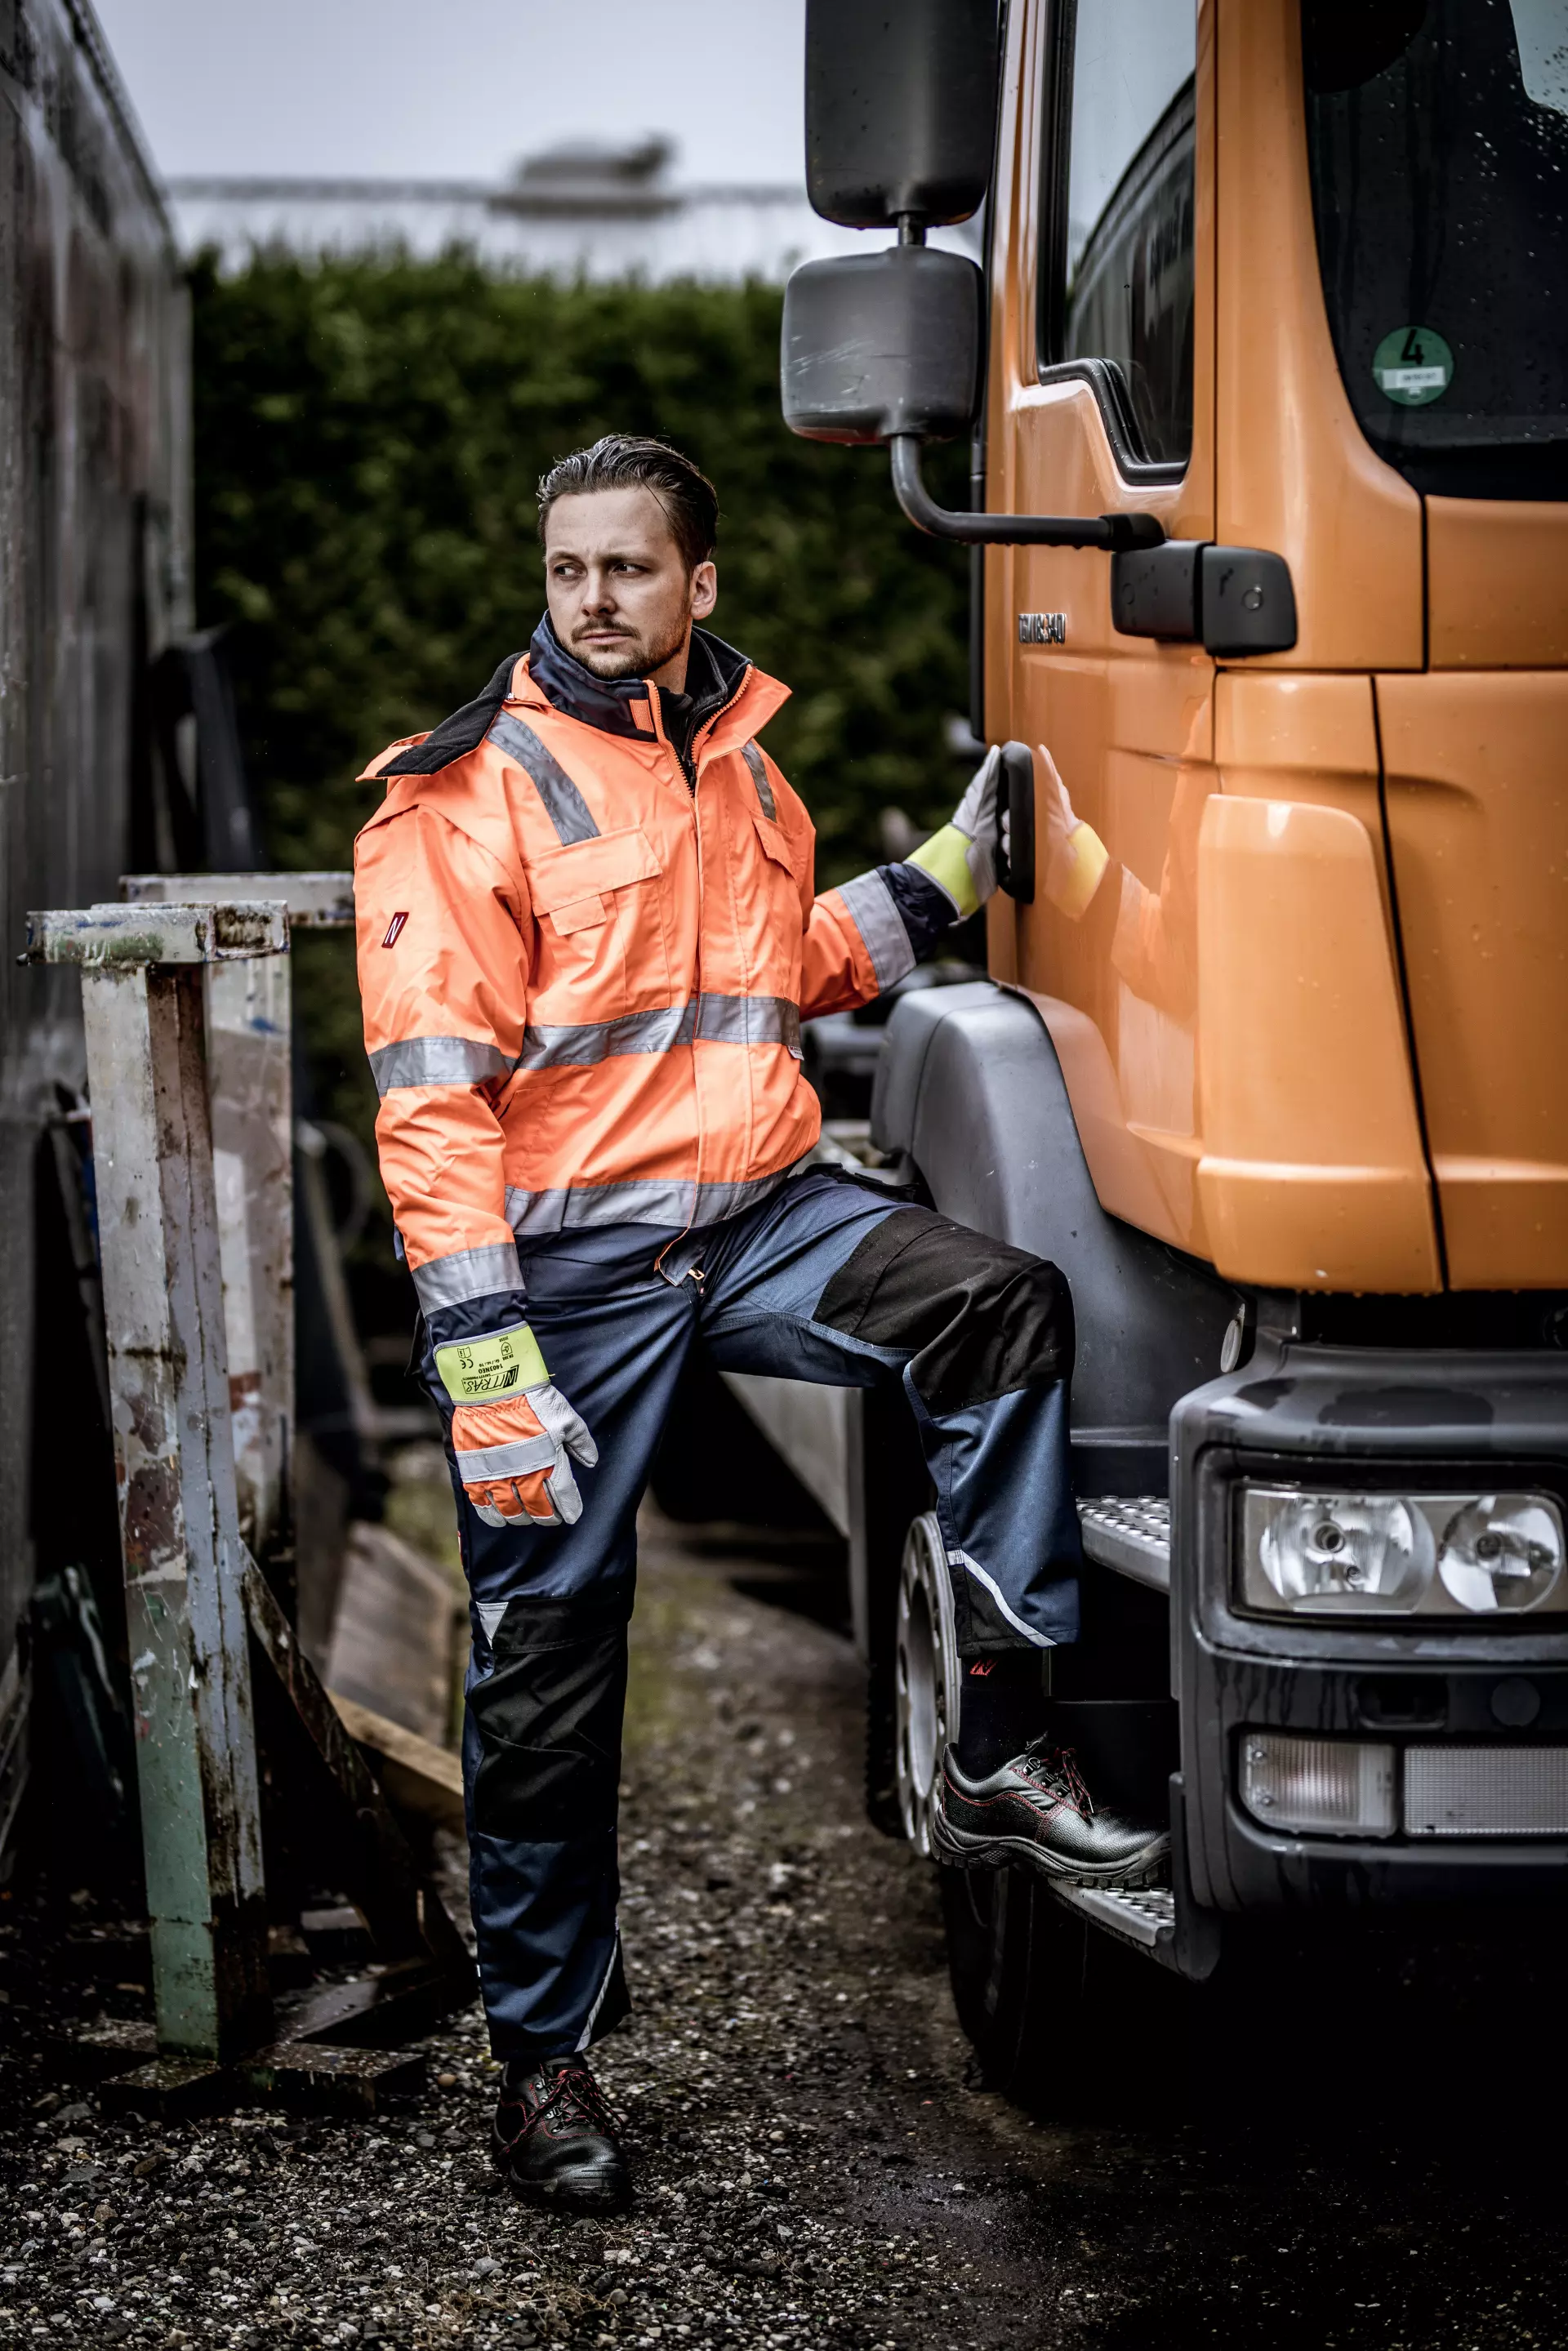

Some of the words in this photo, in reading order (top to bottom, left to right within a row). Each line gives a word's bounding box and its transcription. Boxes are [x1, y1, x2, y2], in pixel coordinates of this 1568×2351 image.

[1401, 328, 1424, 365] 4
[385, 915, 404, 944] N
[466, 1369, 516, 1392] NITRAS
[478, 1364, 503, 1374] 1403NEO
